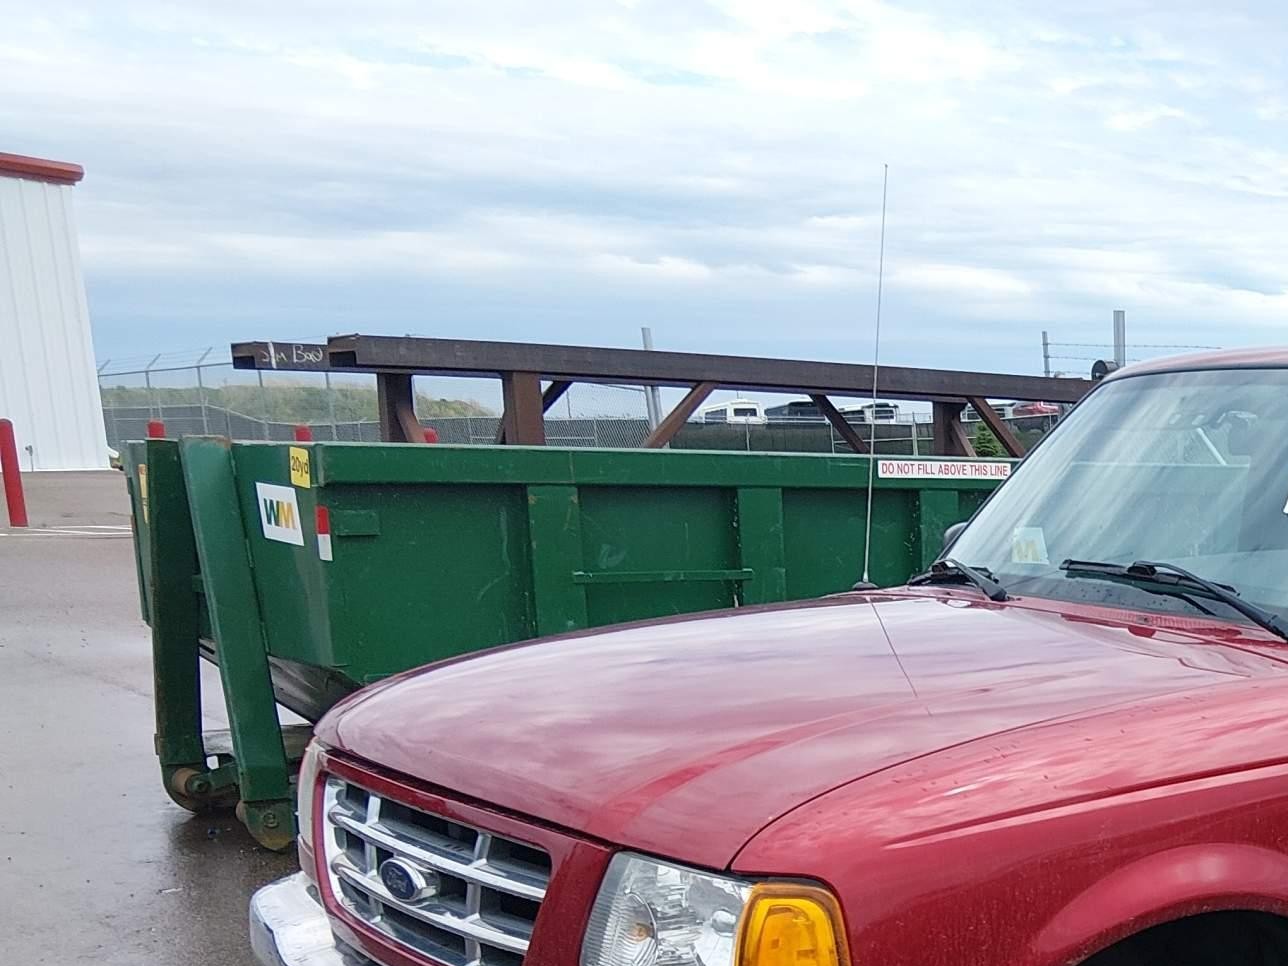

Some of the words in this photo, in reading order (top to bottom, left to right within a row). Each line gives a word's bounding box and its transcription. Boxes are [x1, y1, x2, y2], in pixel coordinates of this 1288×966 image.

[291, 456, 309, 477] 20yd
[881, 462, 895, 474] DO
[897, 462, 916, 474] NOT
[917, 463, 936, 475] FILL
[938, 463, 967, 476] ABOVE
[970, 464, 988, 476] THIS
[990, 465, 1008, 477] LINE
[263, 498, 297, 530] WM
